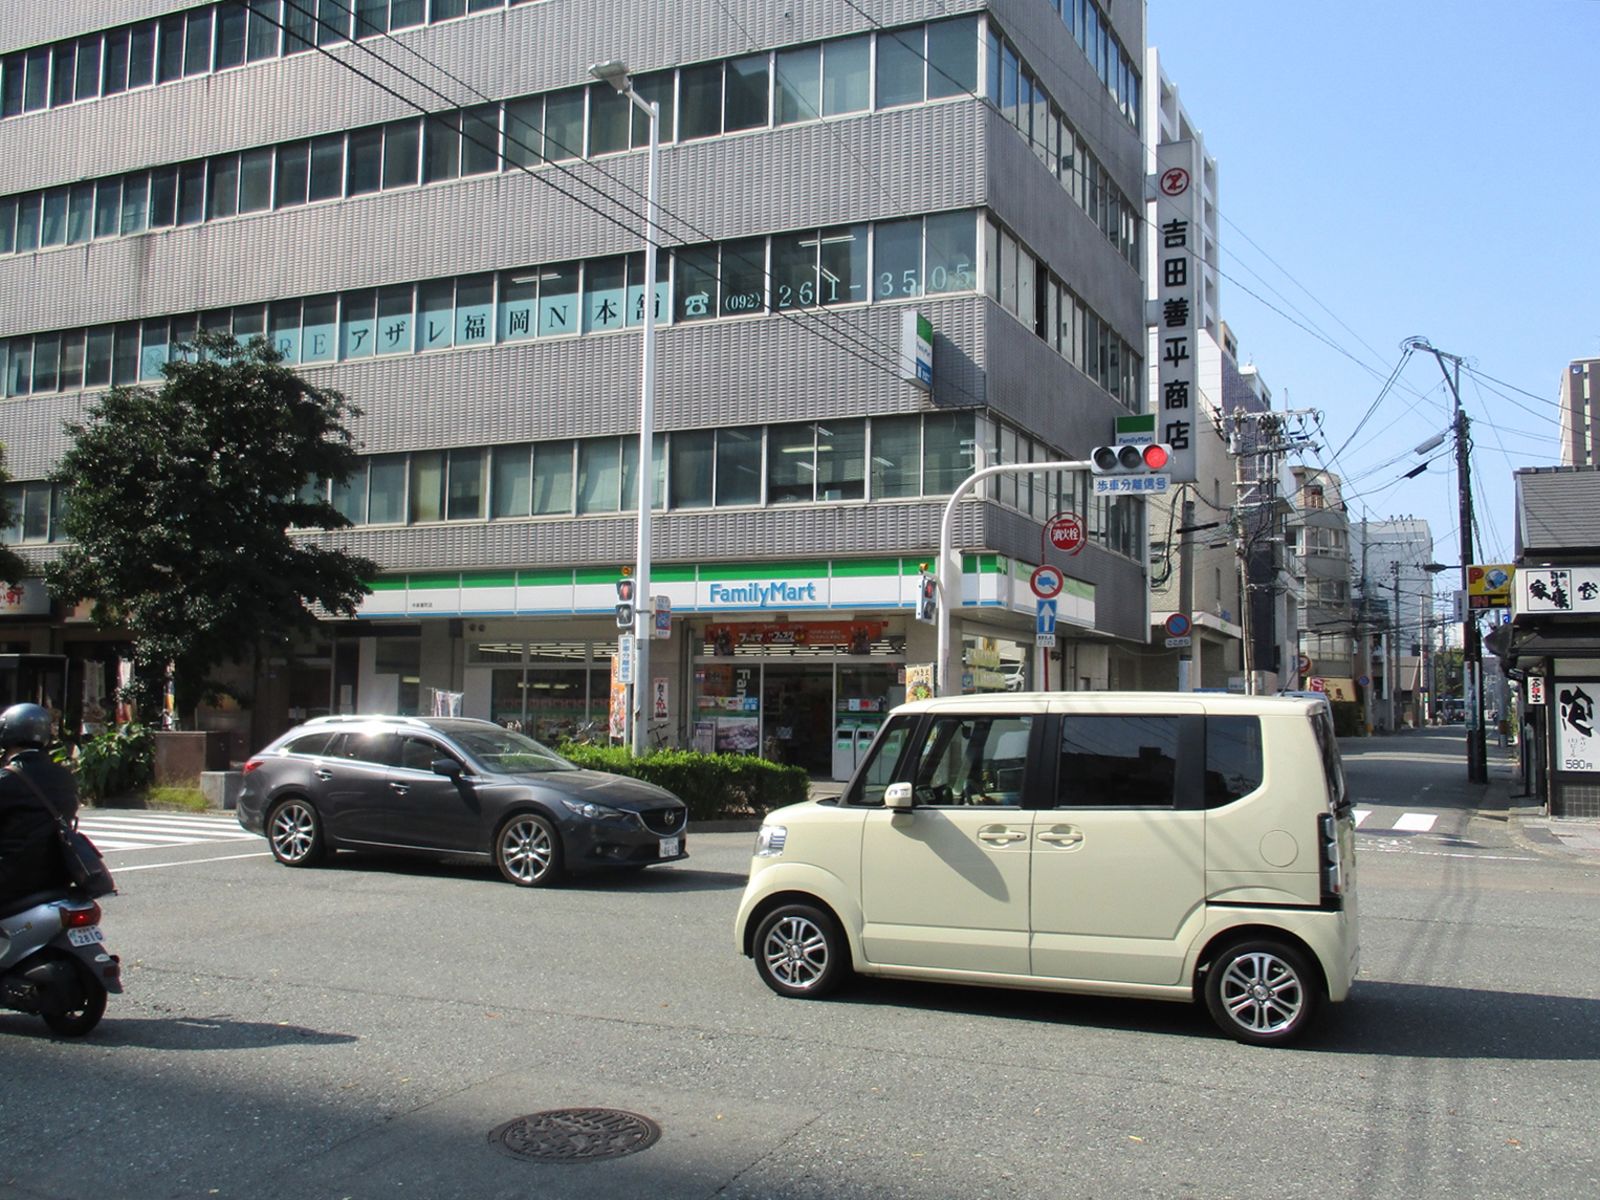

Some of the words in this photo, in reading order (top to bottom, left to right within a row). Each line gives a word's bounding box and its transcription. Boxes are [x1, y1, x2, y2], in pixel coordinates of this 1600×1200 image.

[724, 293, 761, 312] (092)
[1162, 218, 1190, 450] 吉田善平商店
[1096, 477, 1167, 493] 歩車分離信号
[1053, 527, 1079, 541] 消火栓
[709, 582, 816, 607] FamilyMart
[1565, 759, 1593, 770] 580円
